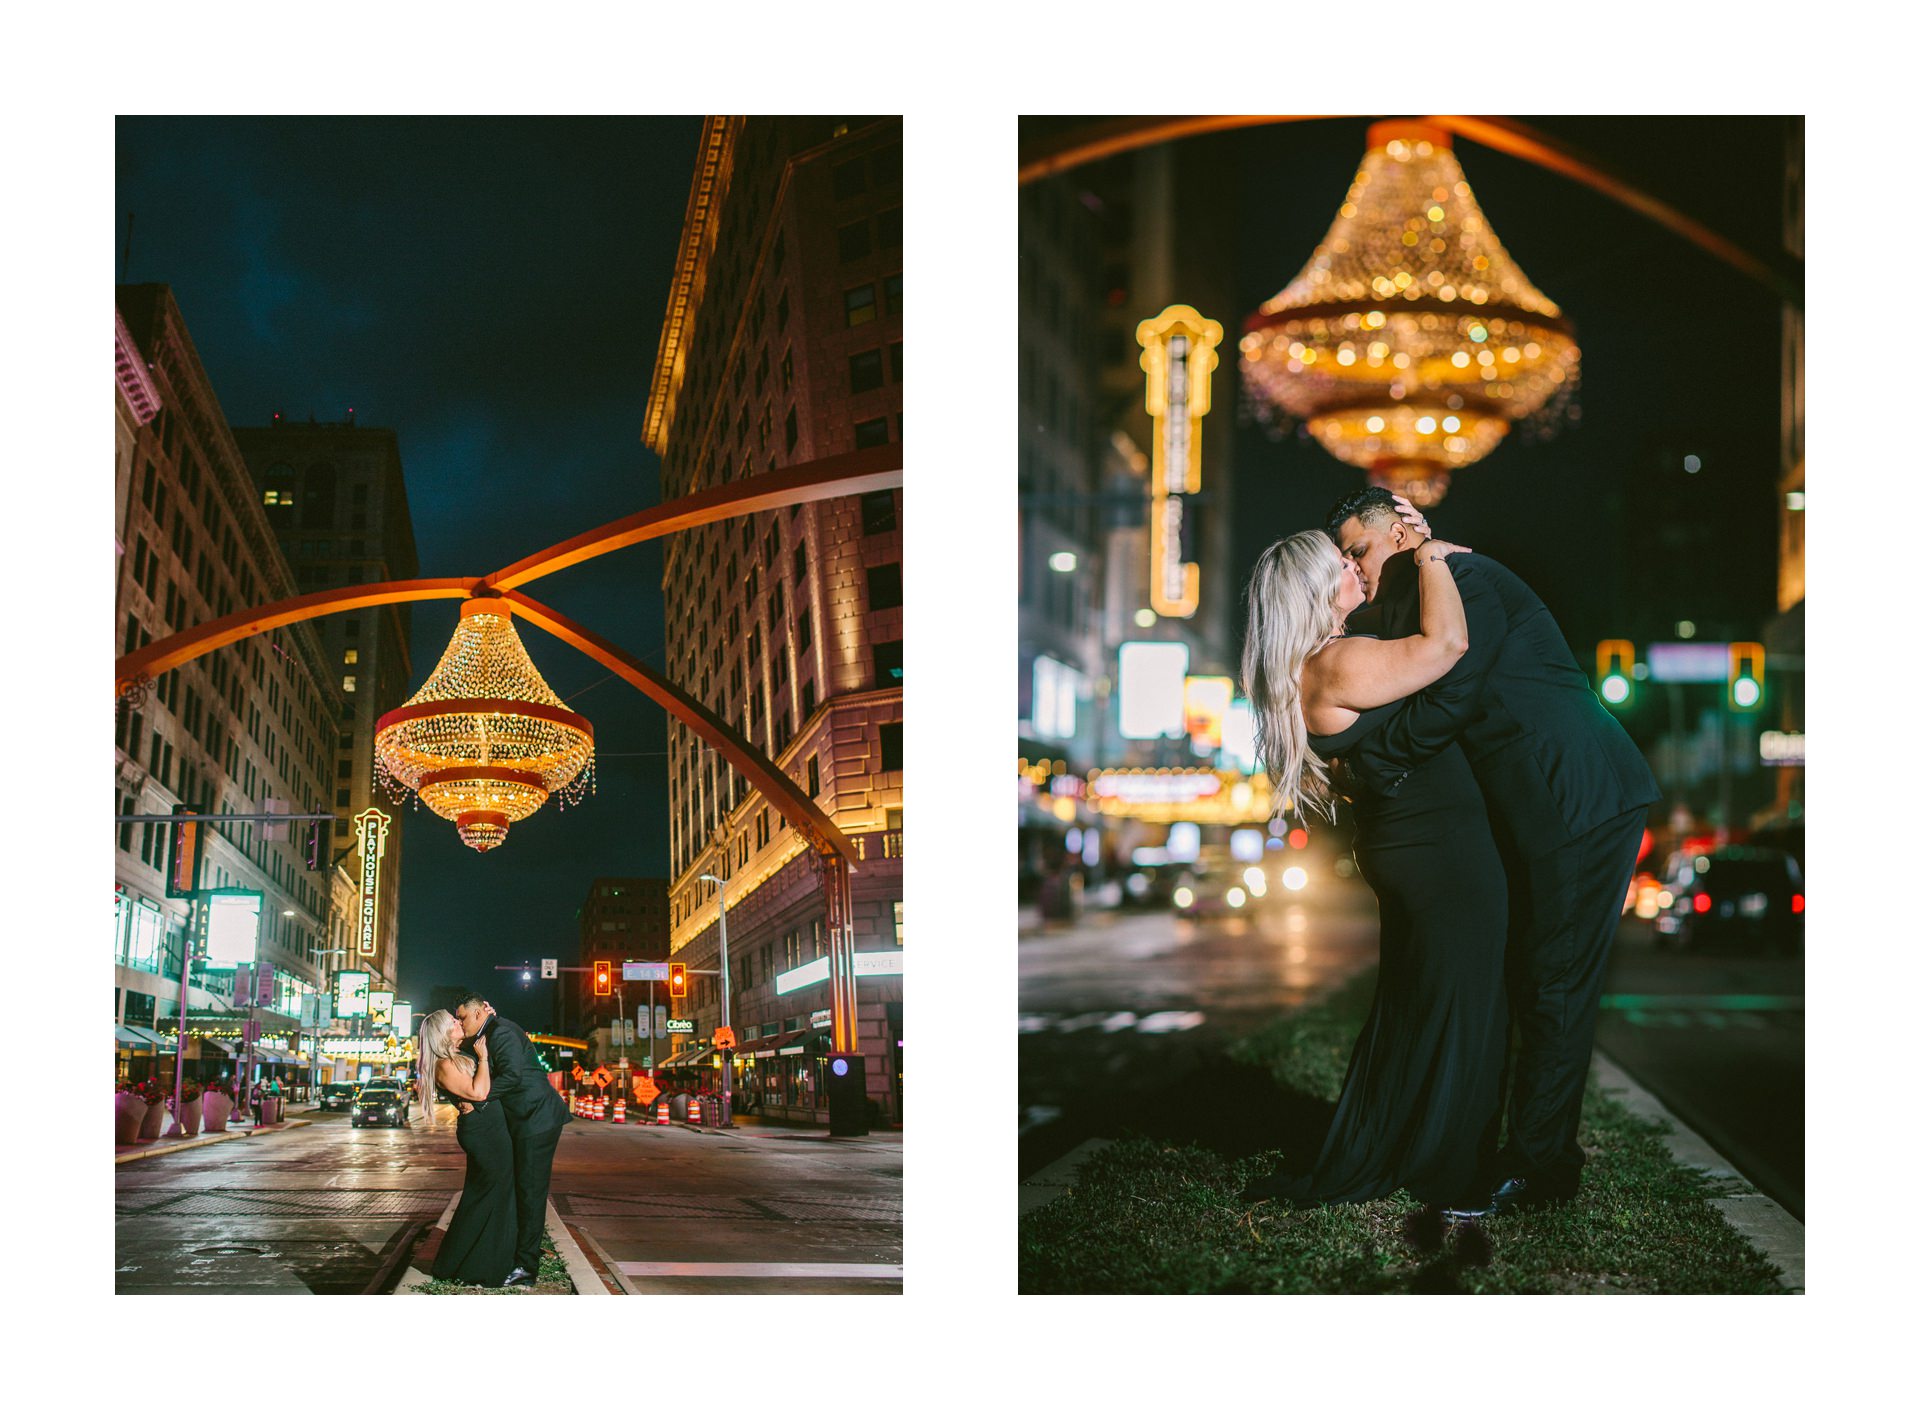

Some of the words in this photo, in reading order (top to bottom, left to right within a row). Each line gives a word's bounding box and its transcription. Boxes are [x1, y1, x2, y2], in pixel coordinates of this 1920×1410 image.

[365, 822, 377, 895] PLAYHOUSE
[198, 904, 208, 957] ALLEN
[362, 898, 374, 950] SQUARE
[854, 958, 896, 969] ERVICE
